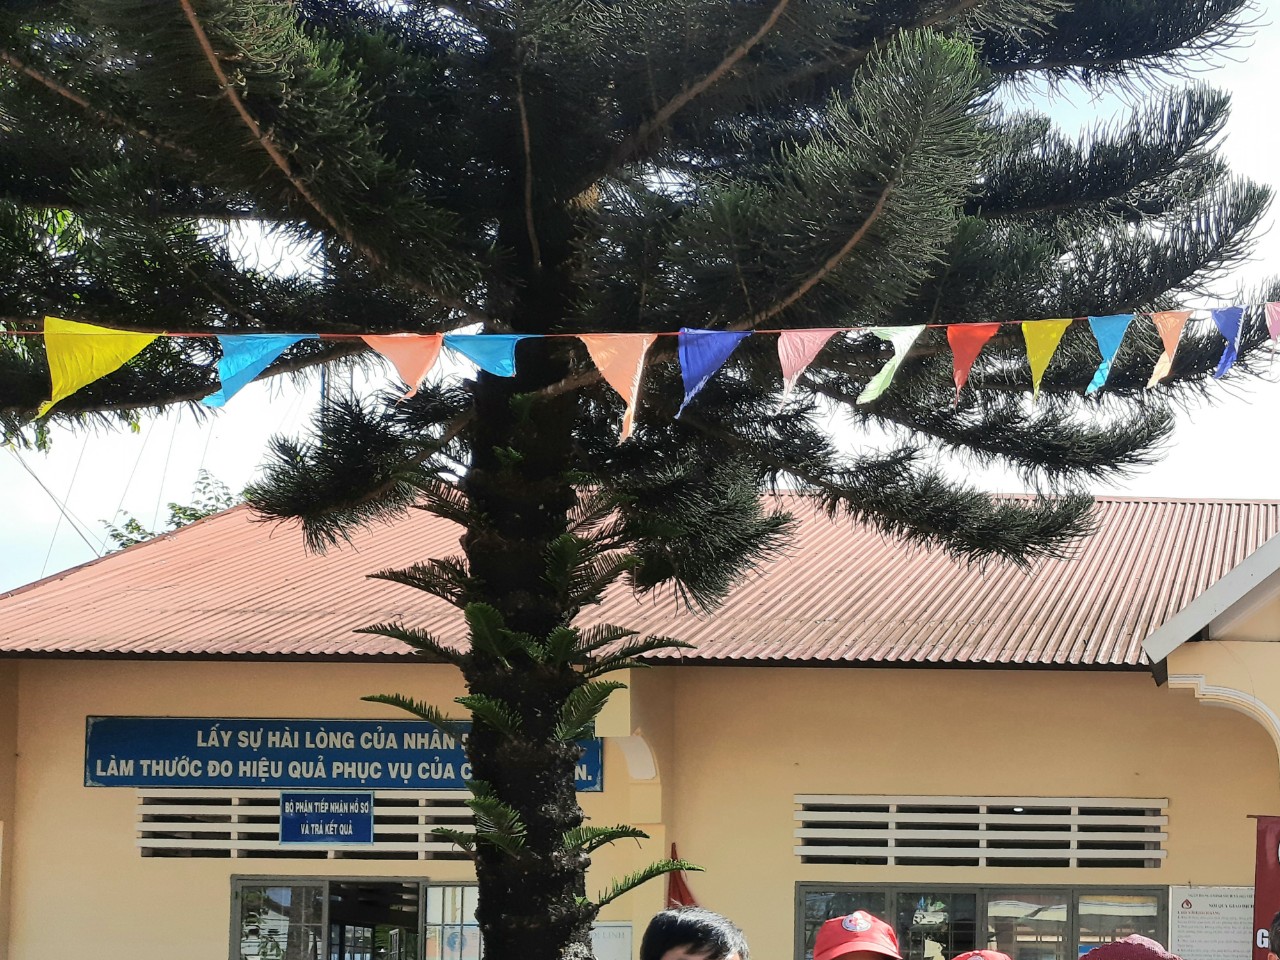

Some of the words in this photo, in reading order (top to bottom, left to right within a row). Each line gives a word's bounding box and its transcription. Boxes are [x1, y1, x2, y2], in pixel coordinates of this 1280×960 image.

[197, 724, 231, 749] LẤY
[238, 726, 262, 752] SỰ
[268, 727, 298, 748] HÀI
[306, 727, 354, 749] LÒNG
[361, 725, 397, 750] CỦA
[403, 728, 455, 750] NHÂN
[97, 755, 133, 776] LÀM
[140, 755, 201, 778] THƯỚC
[208, 760, 232, 778] ĐO
[239, 757, 283, 784] HIỆU
[288, 755, 326, 780] QUẢ
[332, 761, 382, 784] PHỤC
[388, 762, 412, 784] VỤ
[418, 756, 455, 780] CỦA
[285, 799, 294, 816] BỘ
[296, 800, 312, 816] PHẬN
[314, 798, 328, 813] TIẾP
[330, 800, 348, 816] NHẬN
[360, 801, 369, 813] SƠ
[300, 820, 309, 834] VÀ
[311, 820, 323, 834] TRẢ
[325, 820, 337, 834] KẾT
[339, 820, 352, 835] QUẢ
